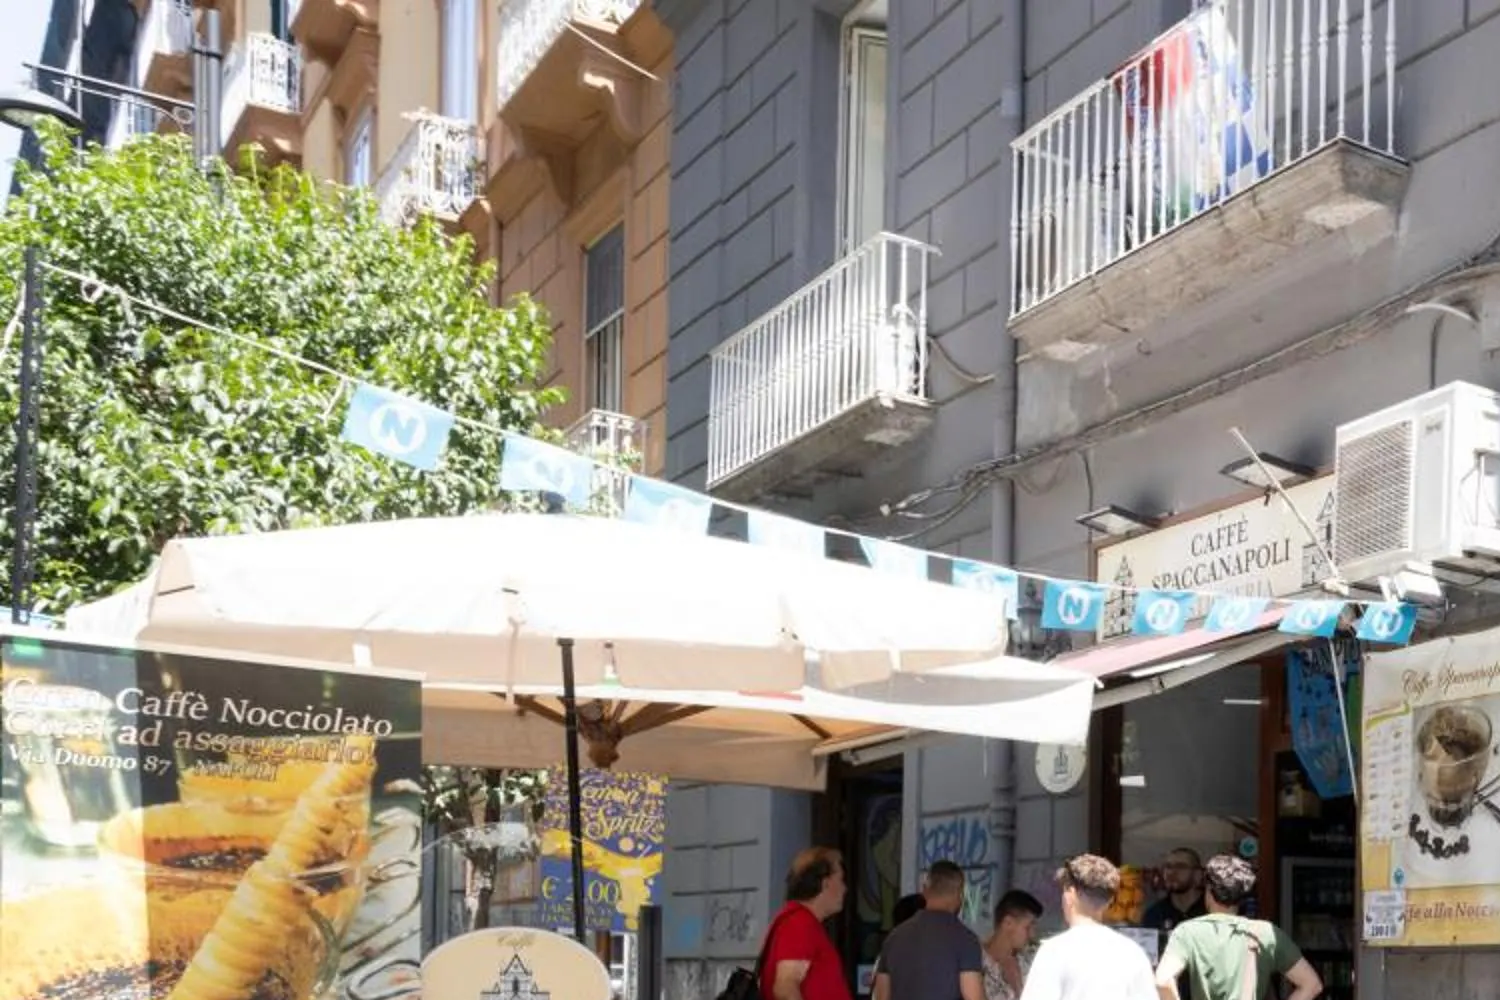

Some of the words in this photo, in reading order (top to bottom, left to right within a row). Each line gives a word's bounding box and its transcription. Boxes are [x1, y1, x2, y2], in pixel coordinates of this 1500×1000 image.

[1191, 512, 1249, 557] CAFFÈ
[1152, 538, 1290, 590] SPACCANAPOLI
[116, 687, 209, 722] Caffè
[220, 697, 393, 737] Nocciolato
[117, 719, 163, 747] ad
[9, 743, 47, 764] Via
[55, 747, 138, 771] Duomo
[143, 755, 173, 776] 87
